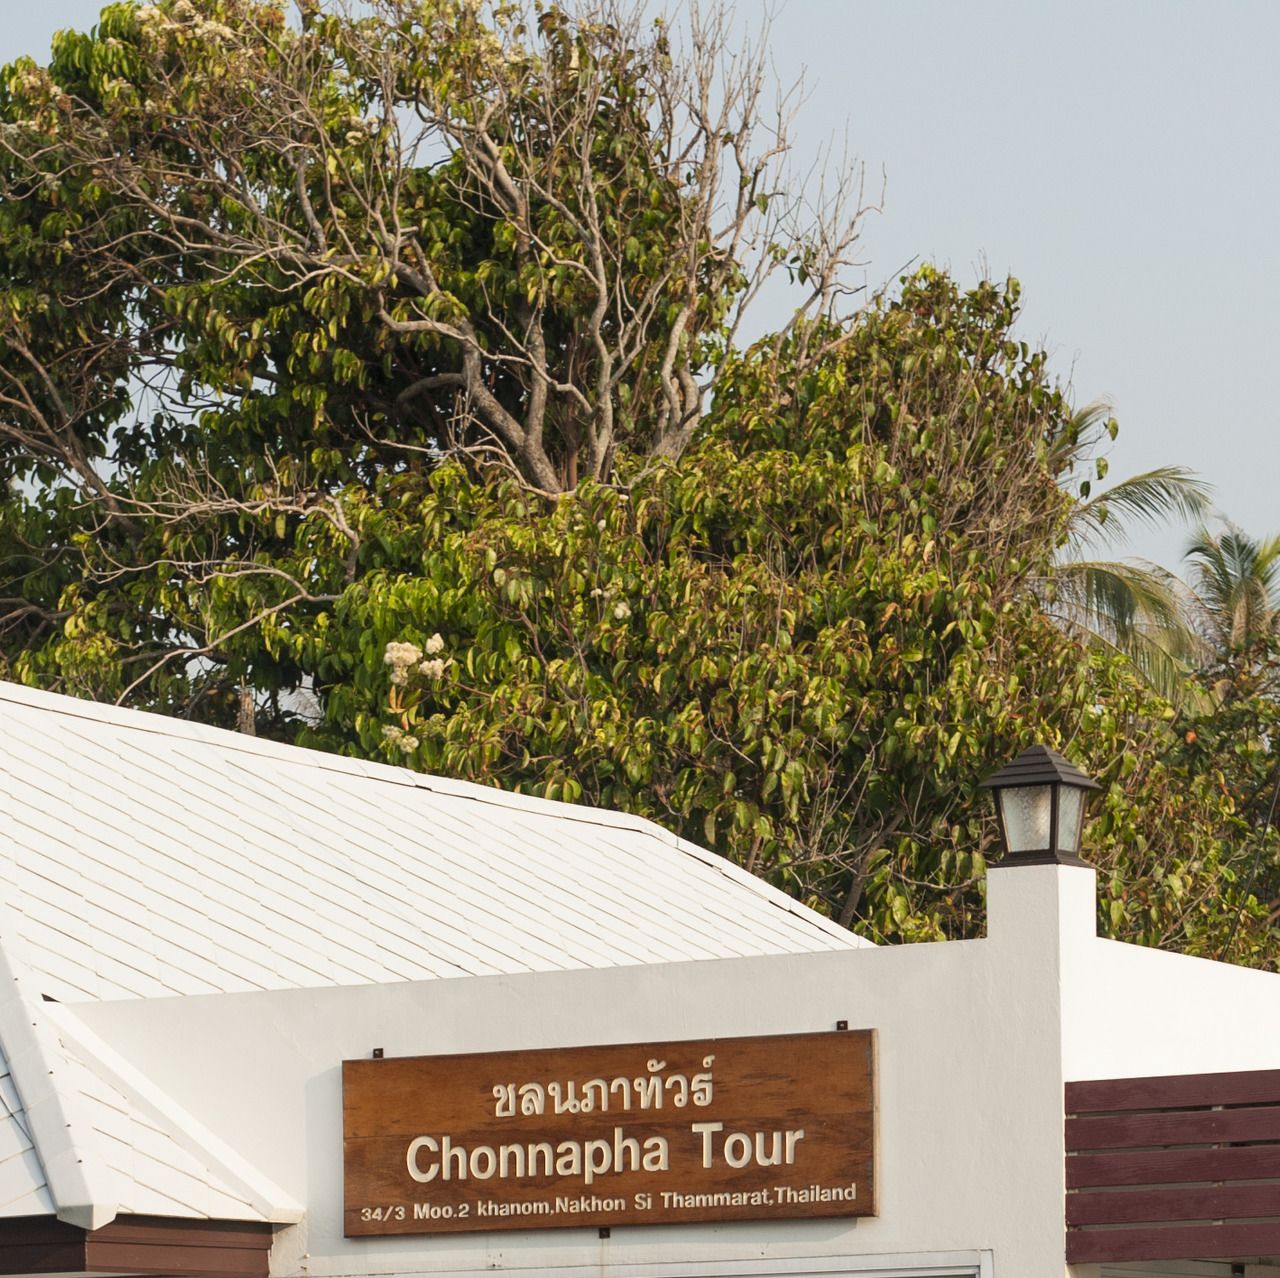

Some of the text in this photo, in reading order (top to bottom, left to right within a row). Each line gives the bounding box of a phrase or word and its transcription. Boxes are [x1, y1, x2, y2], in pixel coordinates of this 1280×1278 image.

[492, 1054, 716, 1118] ชลนภาทัวร์
[405, 1122, 805, 1185] Chonnapha Tour
[360, 1206, 406, 1222] 34/3
[413, 1203, 470, 1220] Moo.2
[634, 1193, 652, 1211] Si
